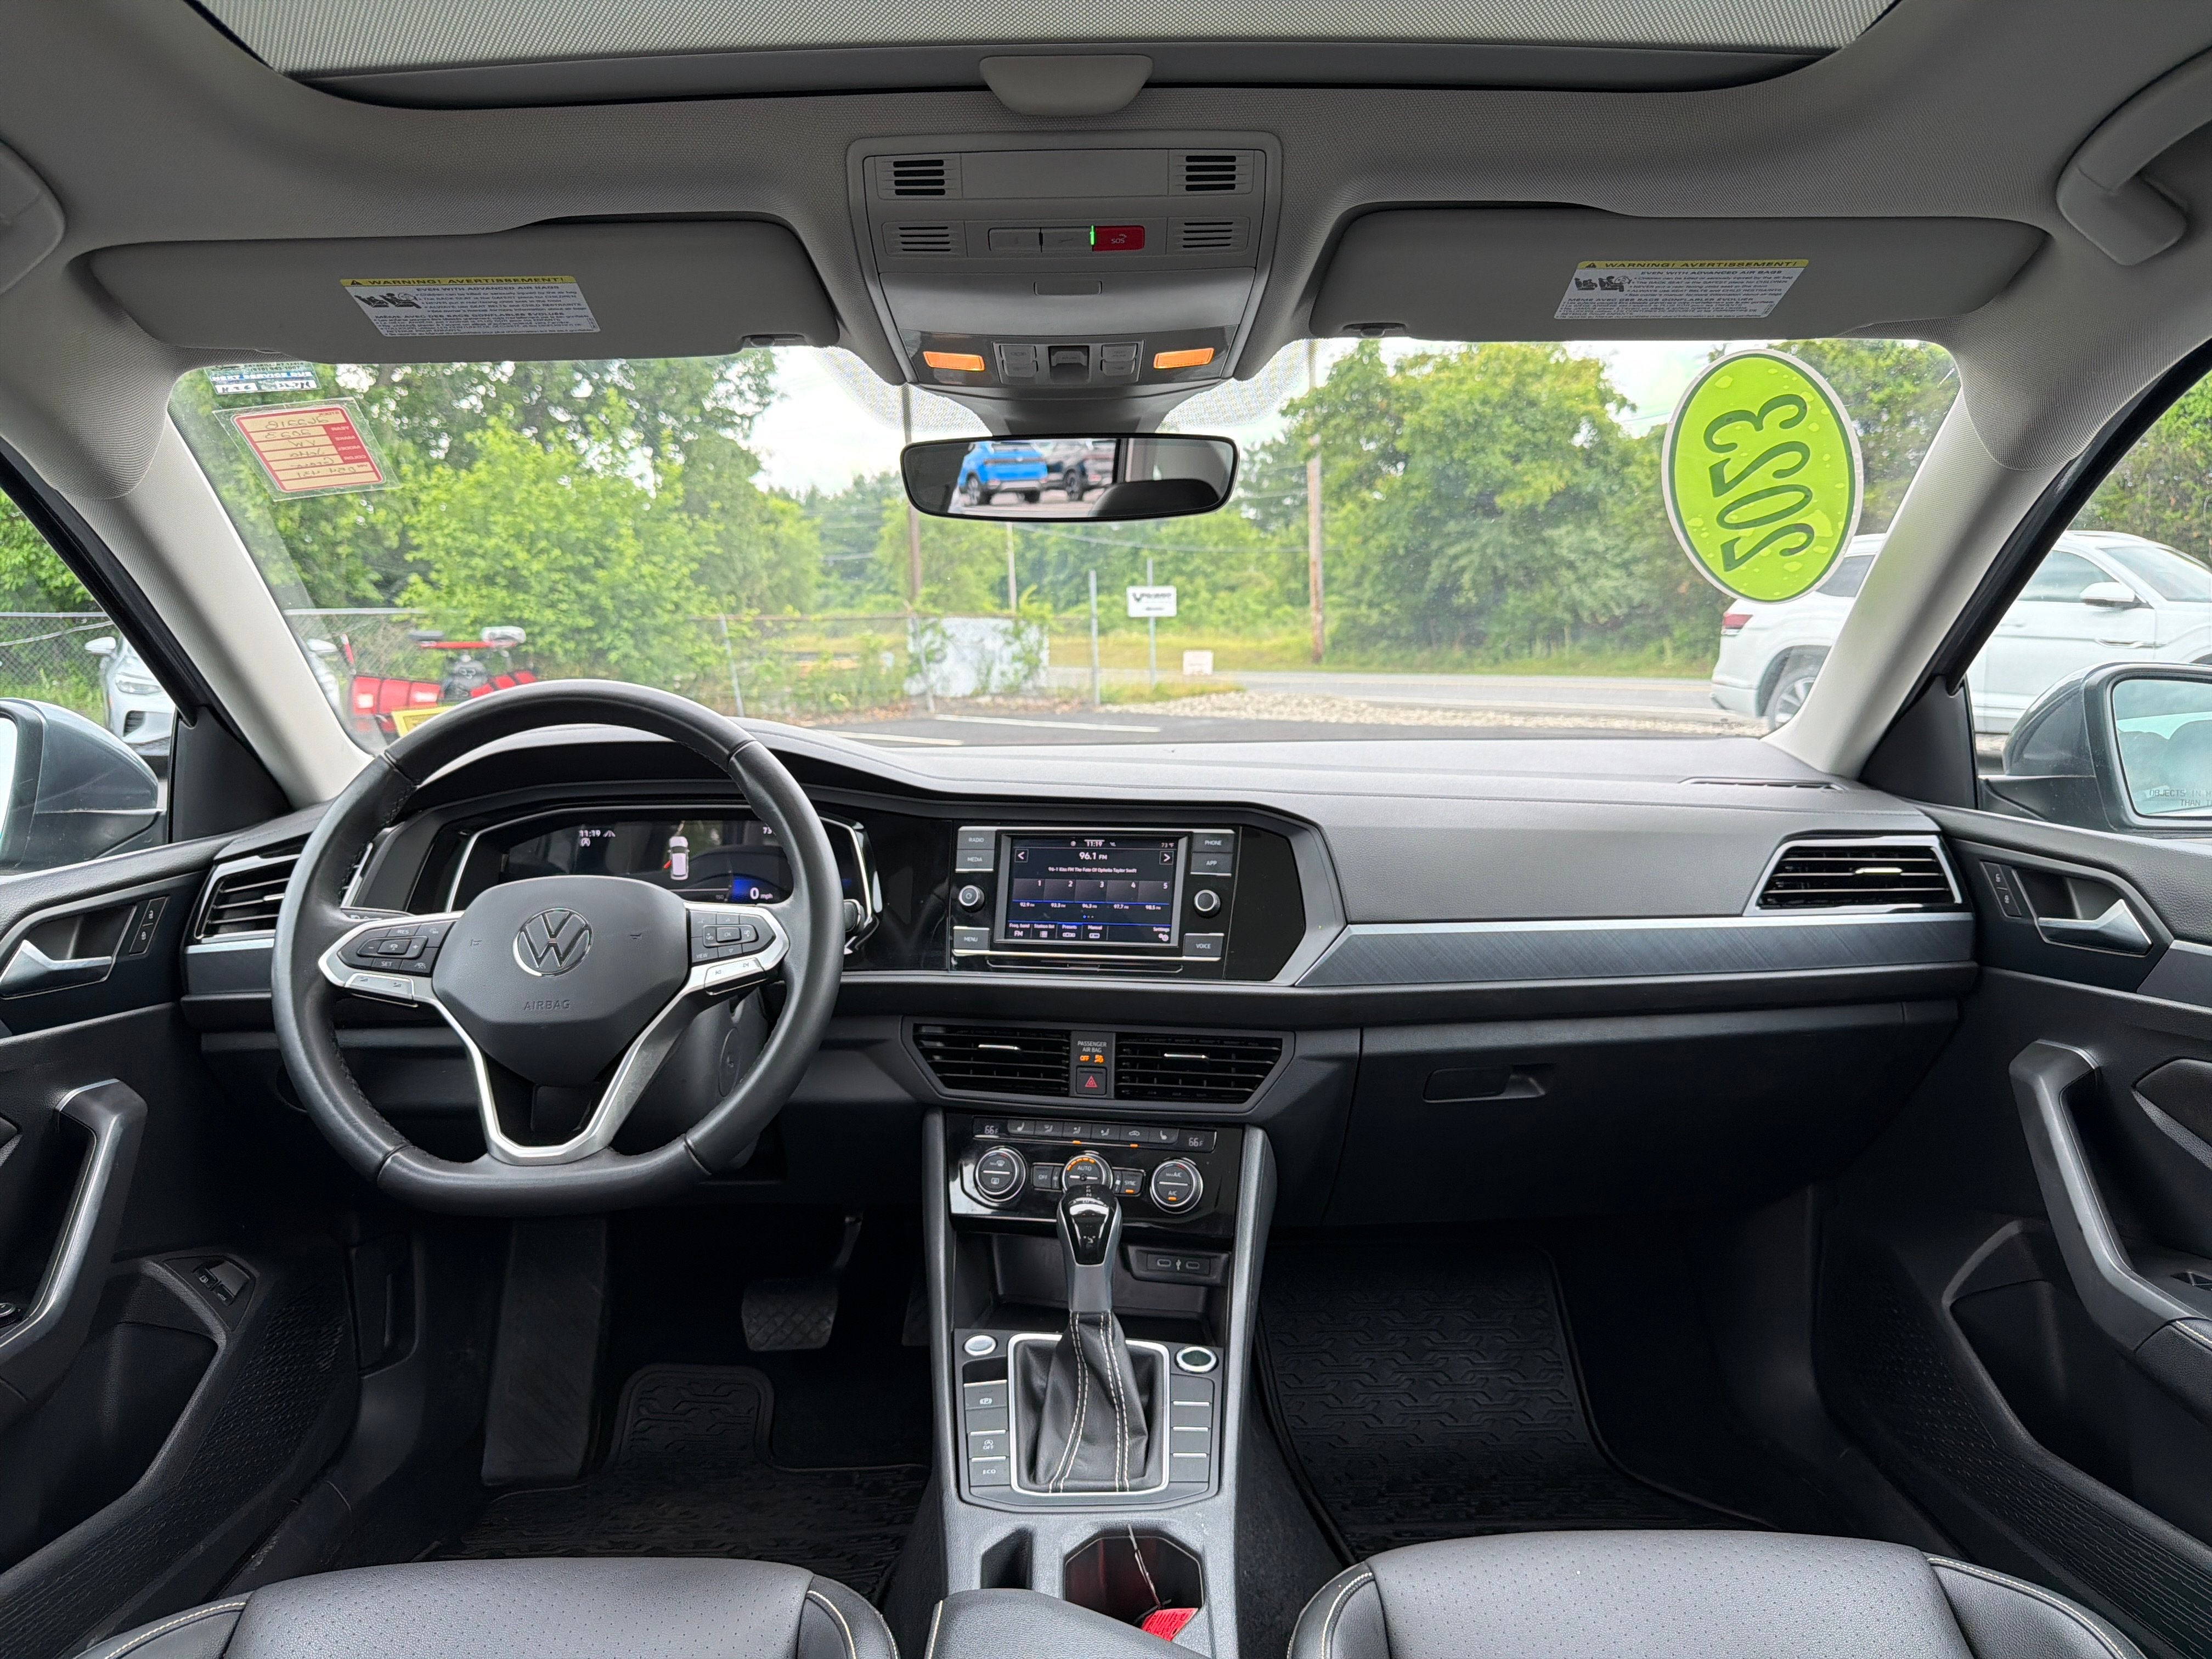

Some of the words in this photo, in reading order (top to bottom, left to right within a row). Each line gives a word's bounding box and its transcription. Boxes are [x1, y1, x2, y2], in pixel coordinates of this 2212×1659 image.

[1079, 851, 1096, 860] 96.1
[750, 887, 759, 899] 0
[513, 908, 594, 977] VW
[523, 1000, 571, 1011] AIRBAG
